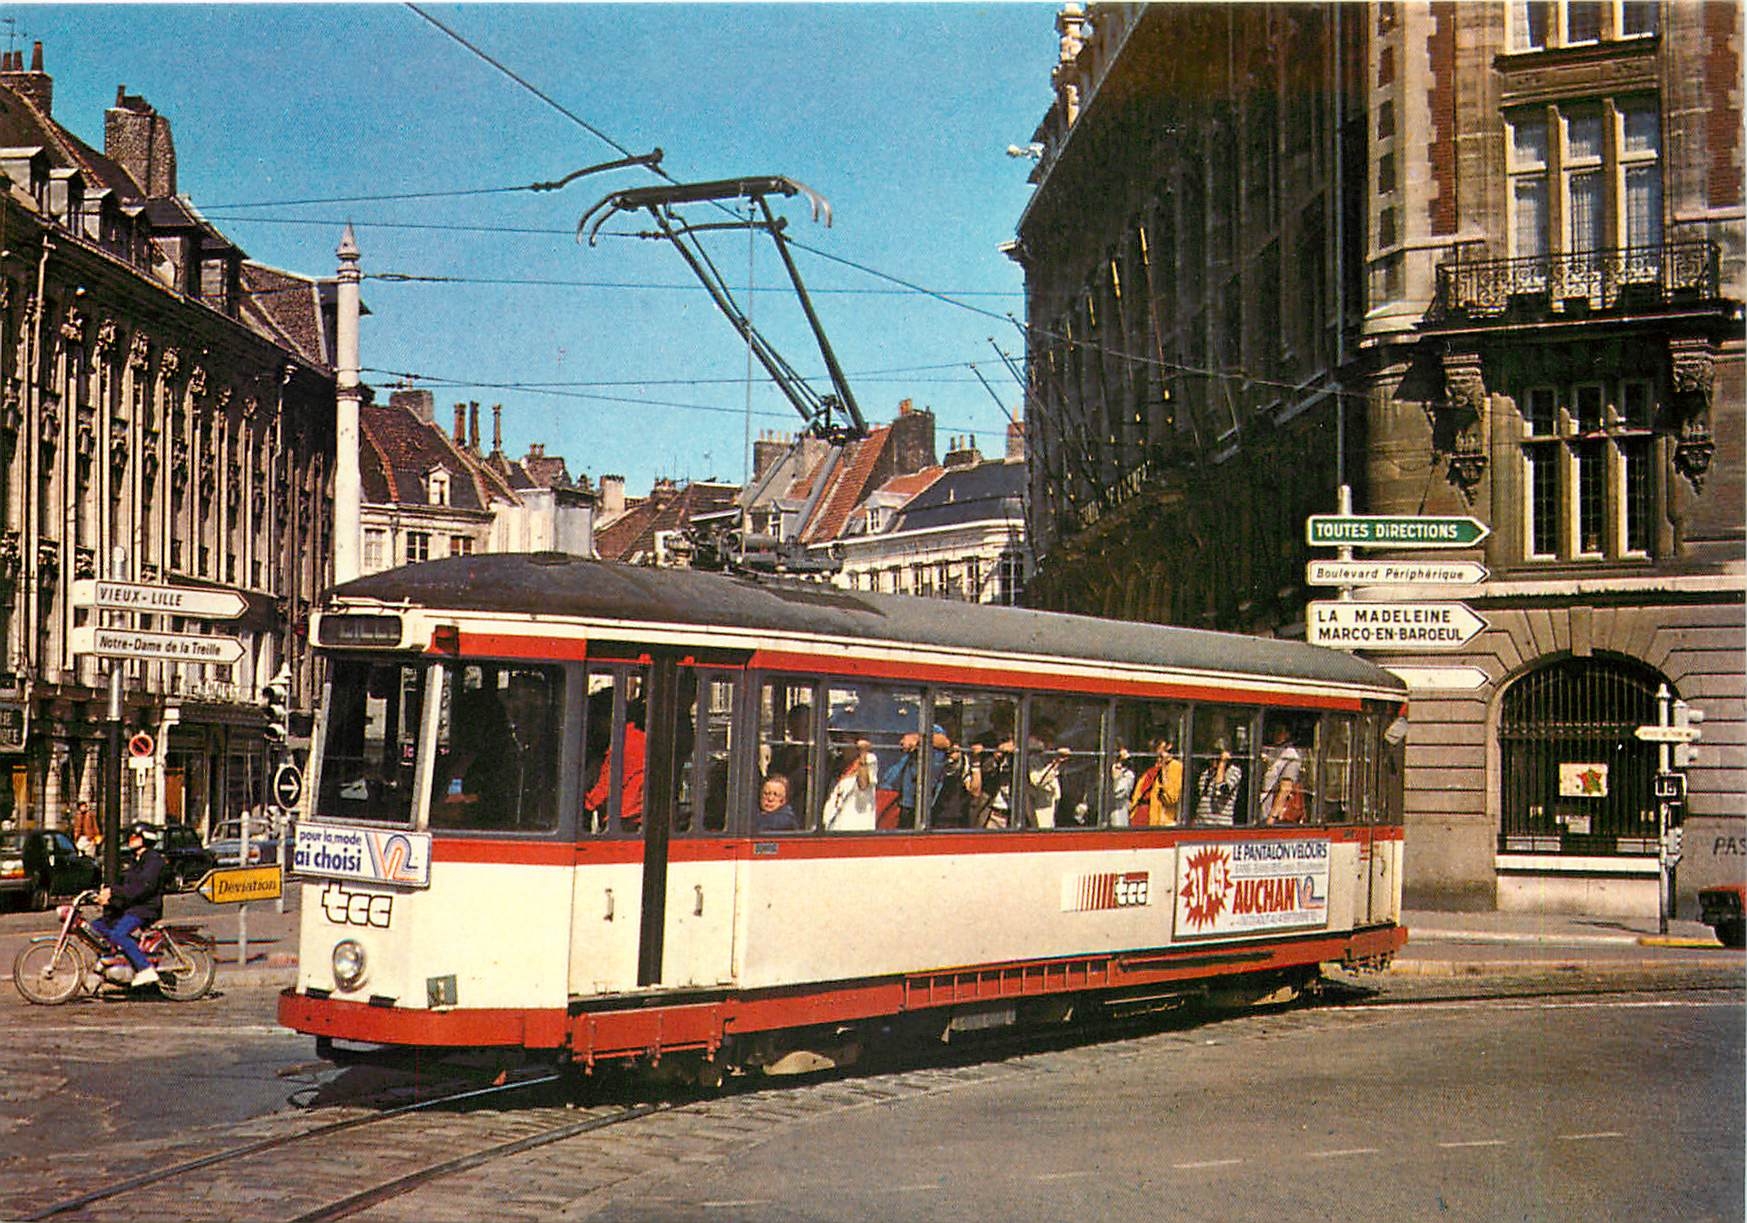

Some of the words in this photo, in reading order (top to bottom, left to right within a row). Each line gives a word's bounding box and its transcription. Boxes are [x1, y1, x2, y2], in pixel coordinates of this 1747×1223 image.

[1316, 523, 1369, 538] TOUTES
[1316, 568, 1379, 579] Boulevard
[1385, 567, 1464, 581] Périphérique
[1318, 610, 1338, 622] LA
[1355, 610, 1451, 623] MADELEINE
[1319, 628, 1464, 641] MARCQ-EN-BAROEUL
[100, 636, 161, 652] Notre-Dame
[165, 641, 177, 653] de
[180, 642, 189, 653] la
[192, 642, 221, 656] Treille
[299, 831, 322, 842] pour
[323, 830, 332, 843] la
[333, 833, 362, 845] mode
[295, 844, 310, 866] ai
[314, 845, 362, 872] choisi
[1233, 845, 1241, 861] LE
[1244, 844, 1290, 861] PANTALON
[1291, 842, 1327, 859] VELOURS
[321, 880, 393, 928] tcc
[1232, 878, 1296, 914] AUCHAN
